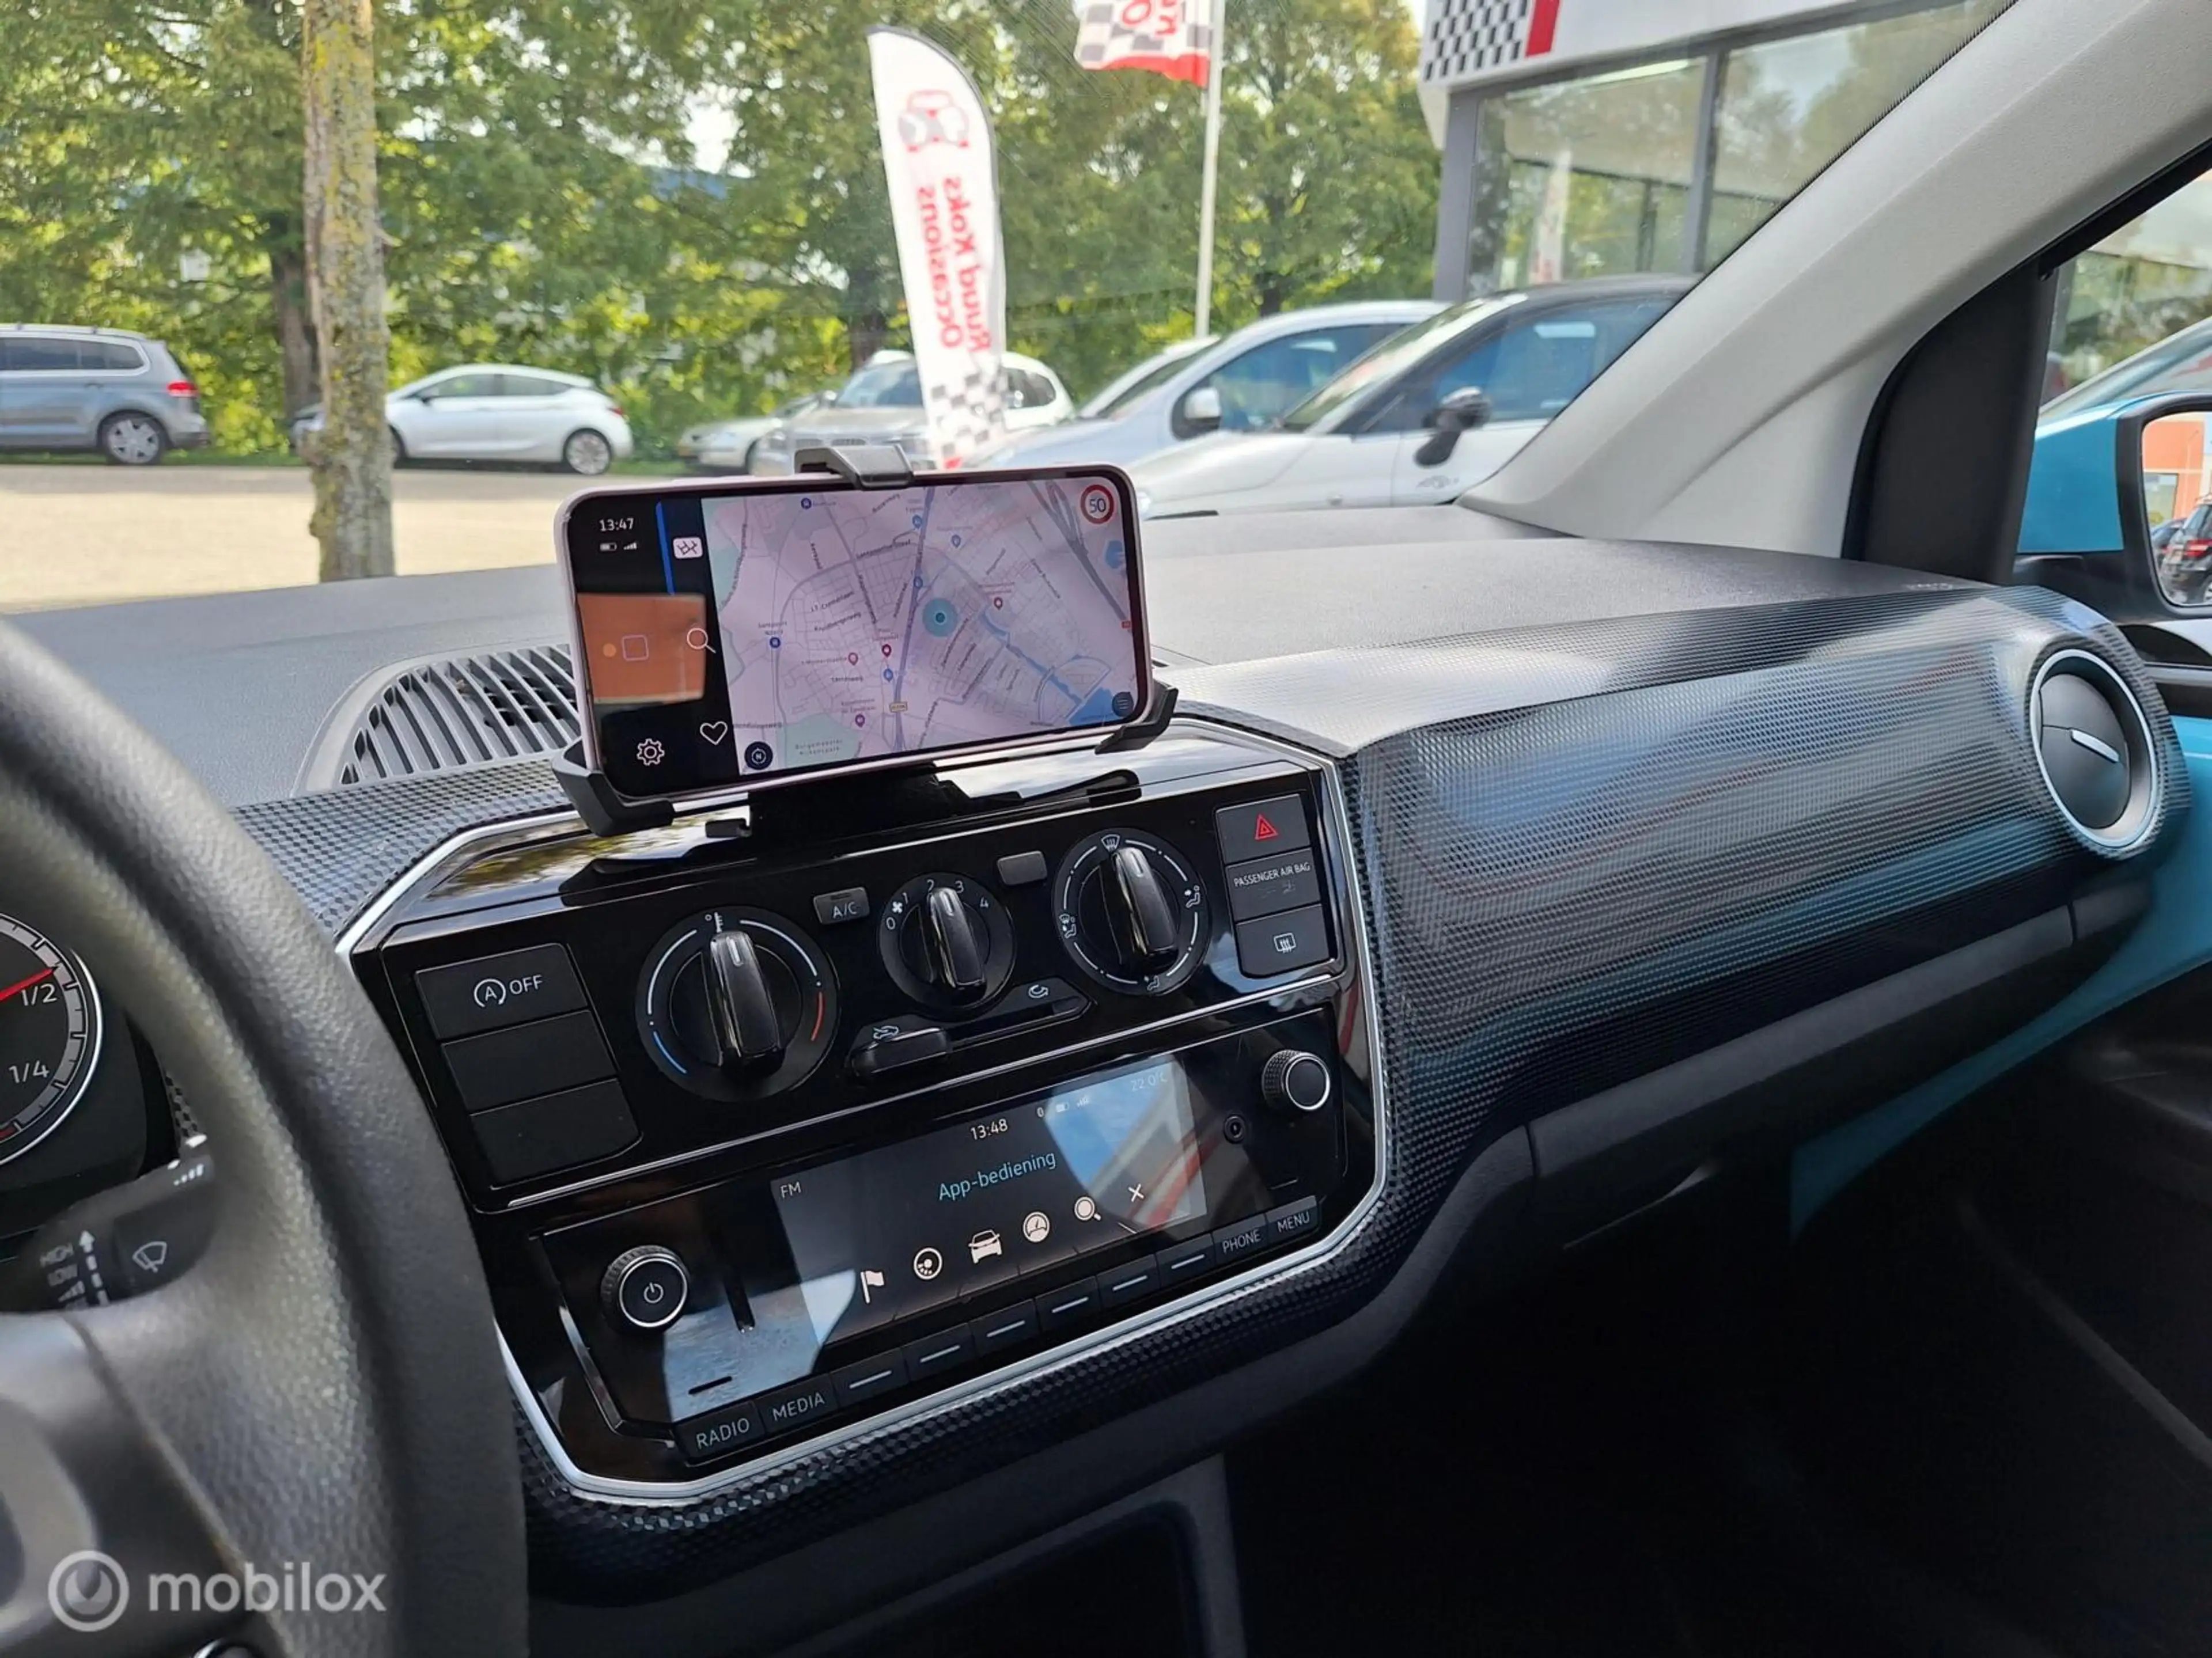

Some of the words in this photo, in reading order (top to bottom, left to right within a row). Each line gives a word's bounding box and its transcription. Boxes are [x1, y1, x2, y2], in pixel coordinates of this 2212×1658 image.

[1089, 498, 1107, 514] 50
[599, 517, 634, 532] 13:47
[1233, 869, 1279, 887] PASSENGER
[1281, 864, 1294, 877] AIR
[1294, 862, 1311, 874] BAG
[833, 901, 857, 919] A/C
[886, 916, 896, 930] 0
[902, 891, 908, 905] 1
[955, 880, 965, 893] 3
[980, 897, 989, 908] 4
[21, 983, 58, 1006] 1/2
[509, 974, 543, 995] OFF
[9, 1060, 50, 1083] 1/4
[970, 1118, 1009, 1141] 13:48
[938, 1152, 1056, 1201] App-bediening
[780, 1181, 802, 1199] FM
[1277, 1211, 1310, 1234] MENU
[1222, 1229, 1262, 1254] PHONE
[772, 1393, 825, 1421] MEDIA
[695, 1417, 750, 1450] RADIO
